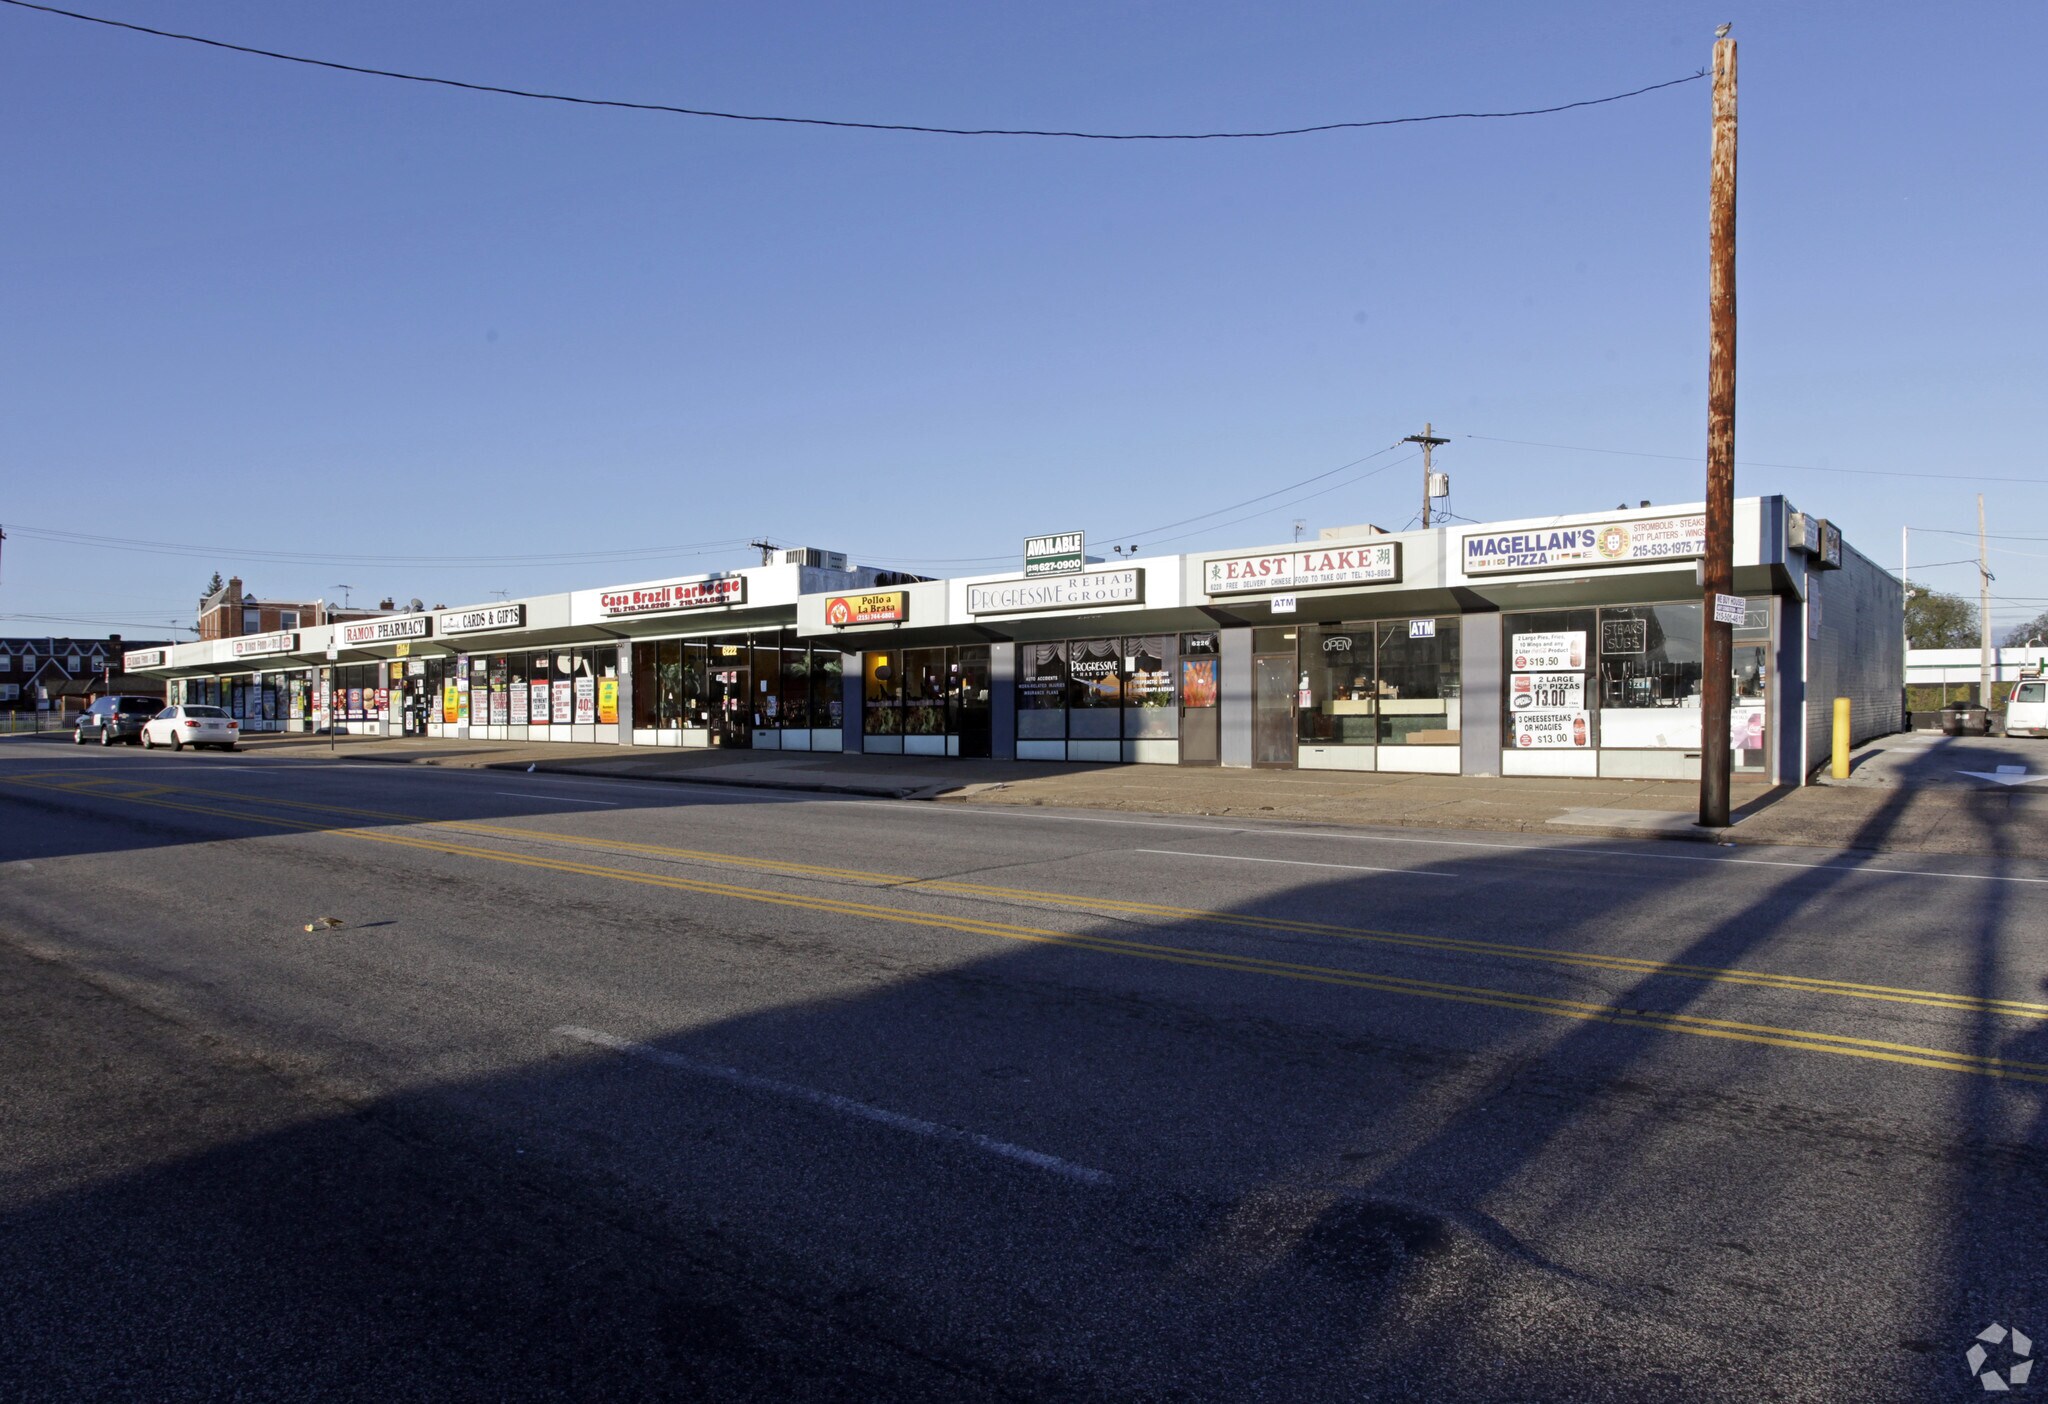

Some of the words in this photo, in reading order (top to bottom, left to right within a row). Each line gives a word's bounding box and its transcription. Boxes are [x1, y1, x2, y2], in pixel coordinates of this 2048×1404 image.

[1633, 521, 1674, 532] STROMBOLIS
[1679, 518, 1705, 528] STEAKS
[1632, 532, 1645, 542] HOT
[1646, 530, 1679, 541] PLATTERS
[1684, 527, 1706, 538] WINGS
[1027, 534, 1081, 558] AVAILABLE
[1468, 529, 1596, 557] MAGELLAN'S
[1226, 557, 1287, 579] EAST
[1303, 549, 1372, 572] LAKE
[1376, 548, 1391, 565] 湖
[1507, 552, 1548, 567] PIZZA
[1039, 558, 1081, 572] 627-0900
[1211, 564, 1222, 580] 東
[1069, 573, 1133, 588] REHAB
[1226, 581, 1238, 590] FREE
[1243, 579, 1266, 588] DELIVERY
[1270, 577, 1292, 586] CHINESE
[1295, 576, 1309, 584] FOOD
[1320, 573, 1334, 581] TAKE
[1336, 572, 1347, 580] OUT
[1351, 571, 1363, 579] TEL:
[601, 594, 629, 607] Casa
[633, 588, 671, 604] Brazil
[675, 580, 739, 599] Barbecue
[862, 596, 884, 605] Pollo
[971, 584, 1063, 609] PROGRESSIVE
[1068, 587, 1133, 602] GROUP
[870, 604, 895, 612] Brasa
[1274, 599, 1293, 607] ATM
[463, 612, 485, 628] CARDS
[488, 611, 494, 625] &
[497, 608, 519, 623] GIFTS
[347, 626, 375, 641] RAMON
[378, 620, 424, 638] PHARMACY
[1411, 621, 1434, 636] ATM
[1604, 622, 1643, 636] STEAKS
[722, 646, 737, 656] 6222
[1322, 638, 1351, 652] OPEN
[1071, 660, 1118, 672] PROGRESSIVE
[1530, 657, 1559, 666] $19.50
[1535, 690, 1566, 706] 13.00
[1523, 714, 1572, 723] CHEESESTEAKS
[1534, 723, 1562, 731] HOAGIES
[1537, 734, 1567, 743] $13.00
